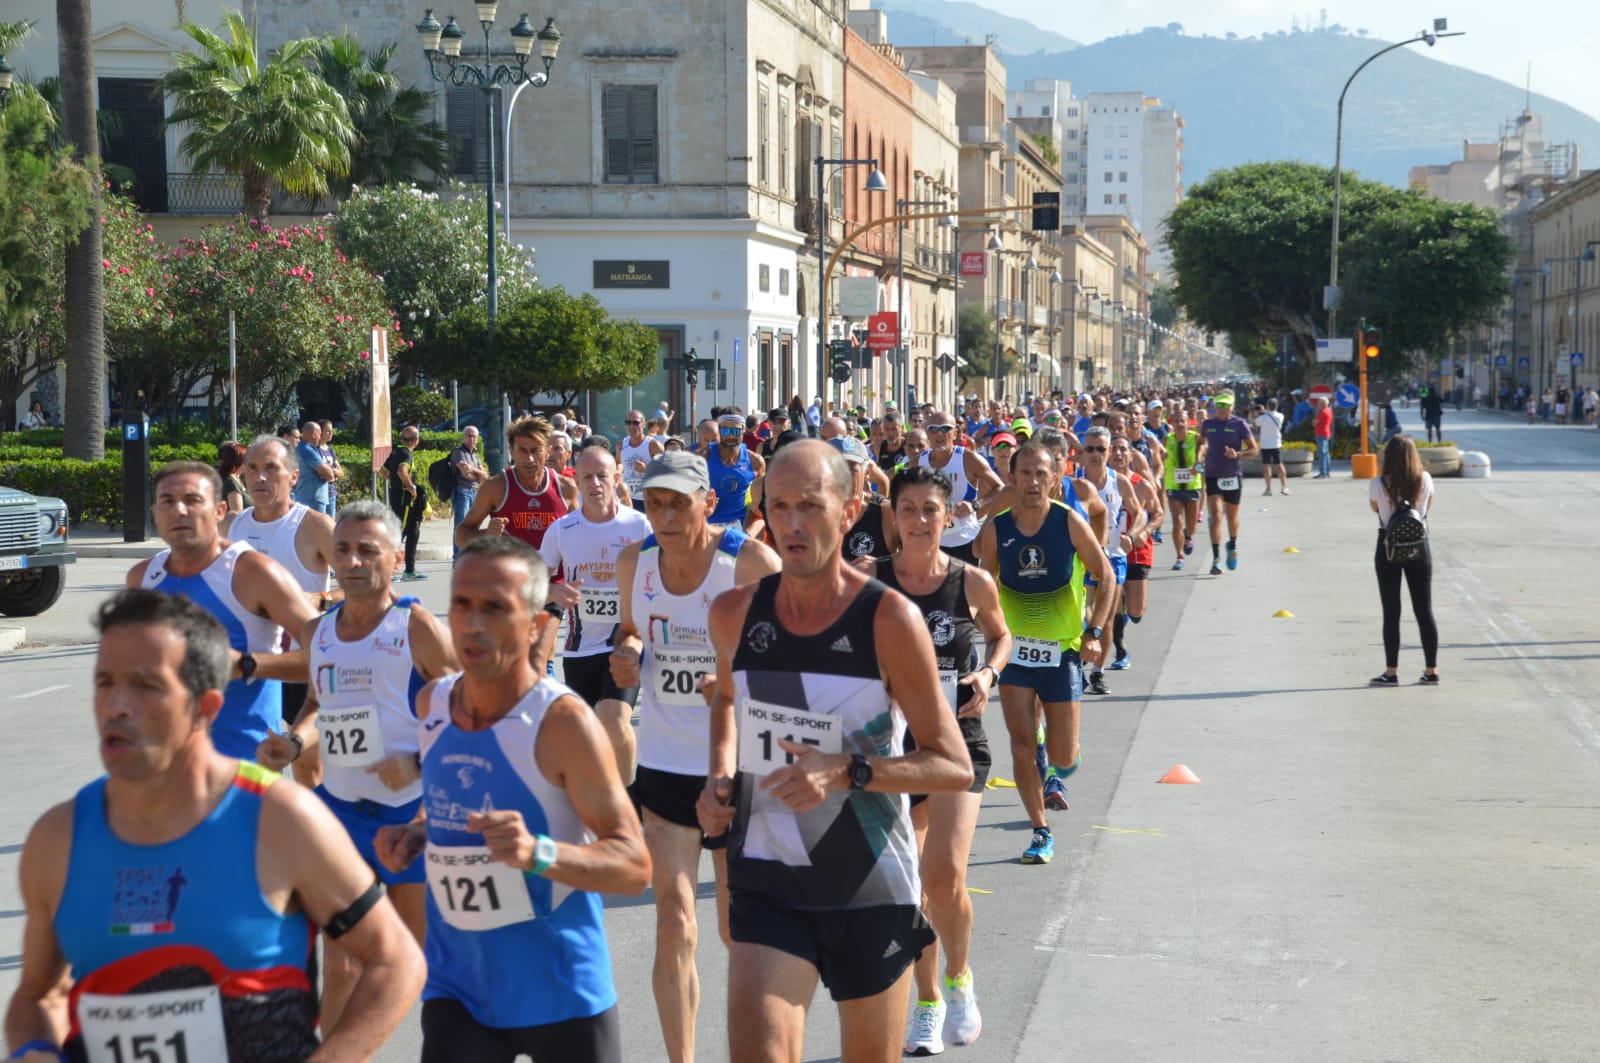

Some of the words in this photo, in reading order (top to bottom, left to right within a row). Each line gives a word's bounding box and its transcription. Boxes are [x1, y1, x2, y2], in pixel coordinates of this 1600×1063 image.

[609, 273, 653, 281] MATRANGA
[127, 425, 136, 439] P
[585, 599, 618, 616] 323
[1017, 646, 1052, 664] 593
[325, 728, 368, 755] 212
[758, 729, 820, 765] 11
[440, 875, 502, 912] 121
[105, 1029, 191, 1063] 151
